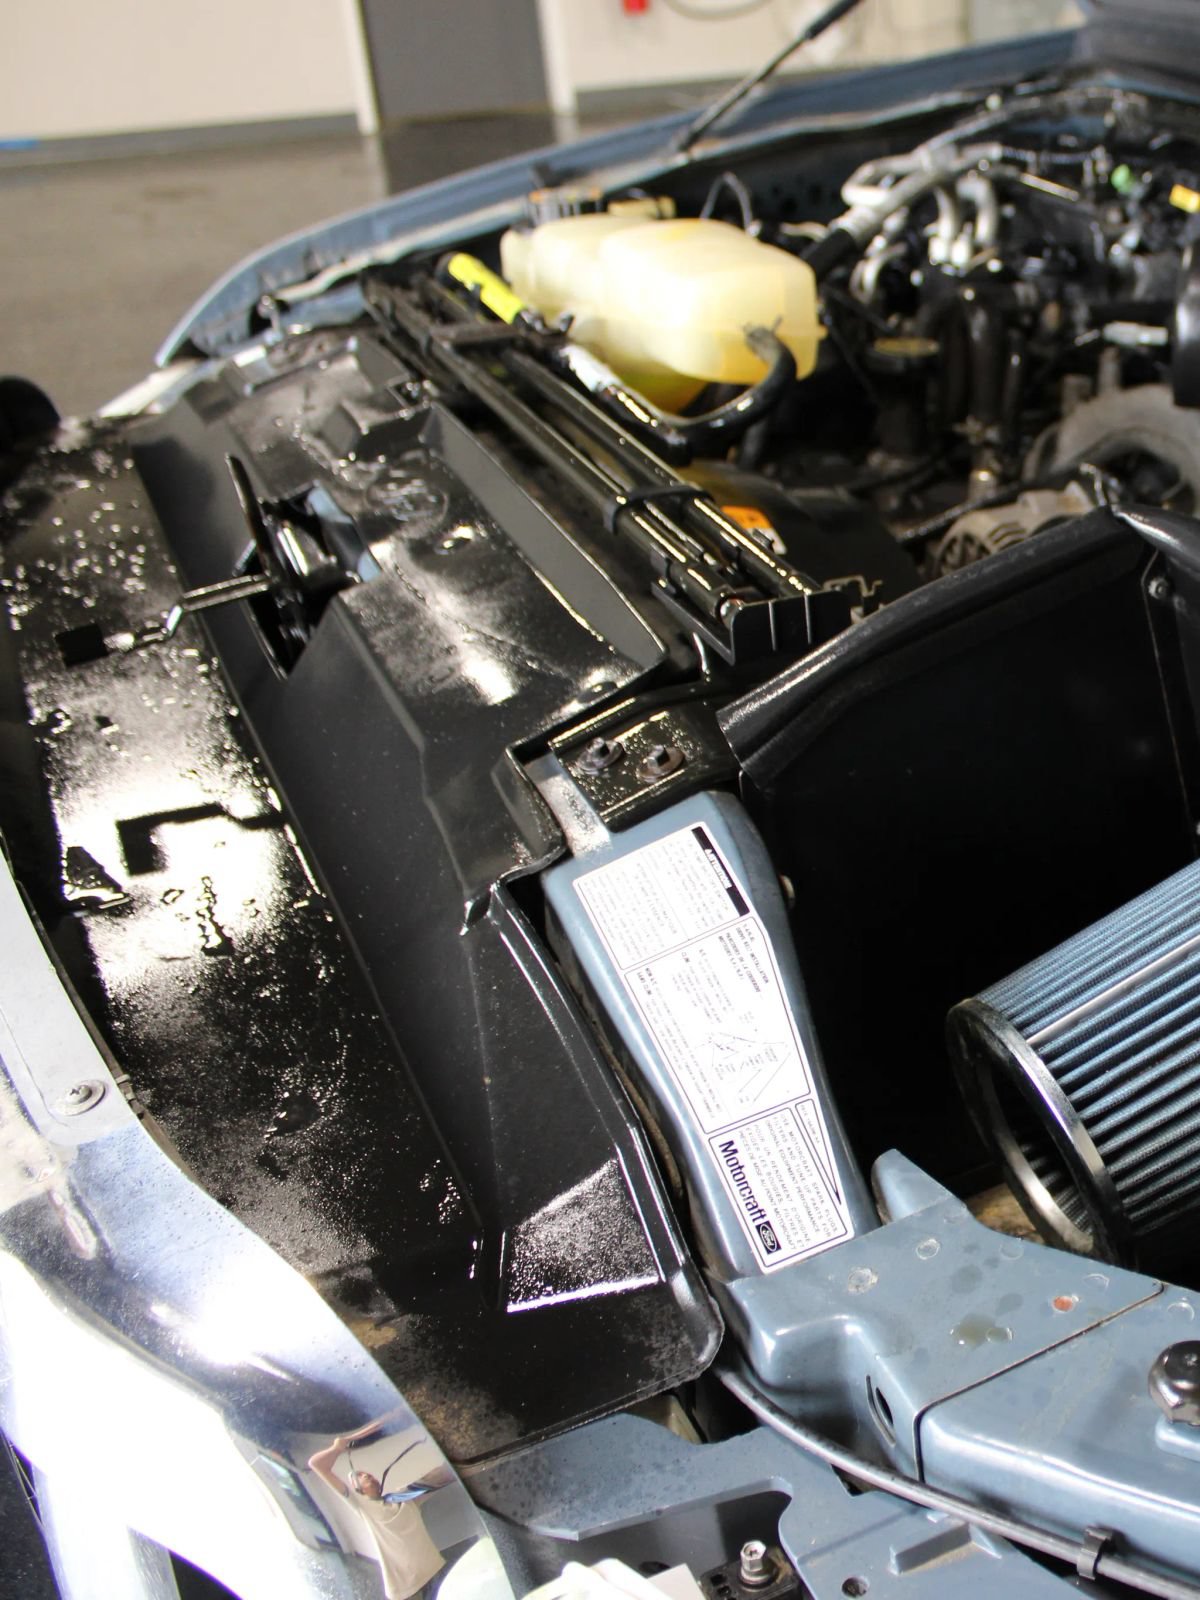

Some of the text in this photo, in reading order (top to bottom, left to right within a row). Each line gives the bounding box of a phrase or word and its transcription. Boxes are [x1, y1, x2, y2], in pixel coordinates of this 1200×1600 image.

[719, 1140, 767, 1223] Motorcraft
[788, 1130, 813, 1176] MOTORCRAFT
[811, 1182, 825, 1205] SPARK
[810, 1197, 823, 1220] PARTS
